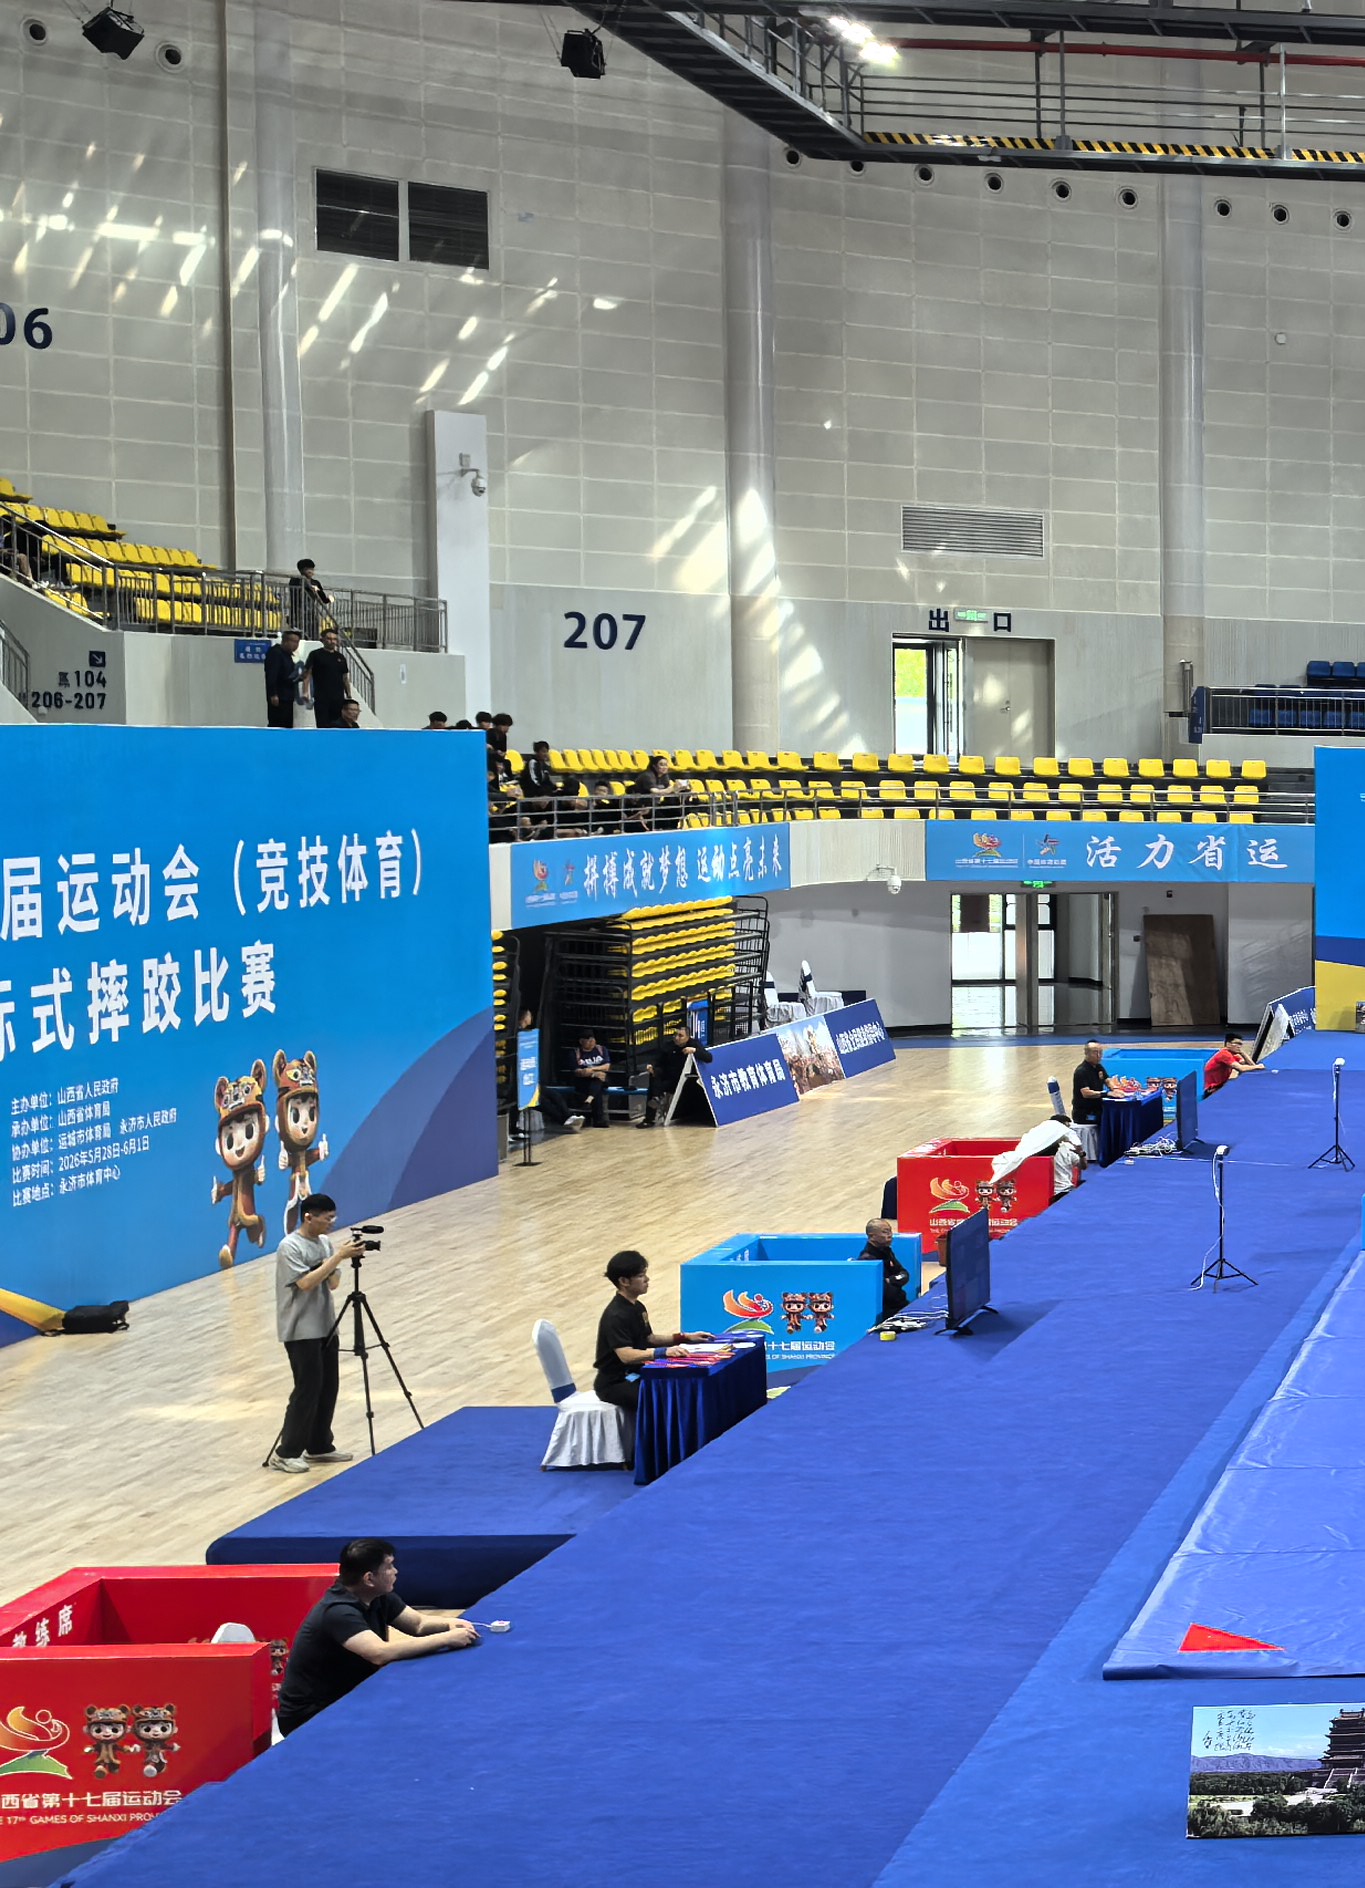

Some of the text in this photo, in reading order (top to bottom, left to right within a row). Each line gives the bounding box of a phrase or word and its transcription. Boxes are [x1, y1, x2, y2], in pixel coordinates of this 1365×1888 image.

[563, 611, 647, 652] 207
[1085, 832, 1290, 871] 活力省运
[0, 828, 423, 942] 届运动会（竞技体育）
[710, 1057, 787, 1101] 永济市教育体育局
[29, 1813, 68, 1825] GAMES
[69, 1813, 84, 1825] OF
[86, 1812, 128, 1824] SHANXI
